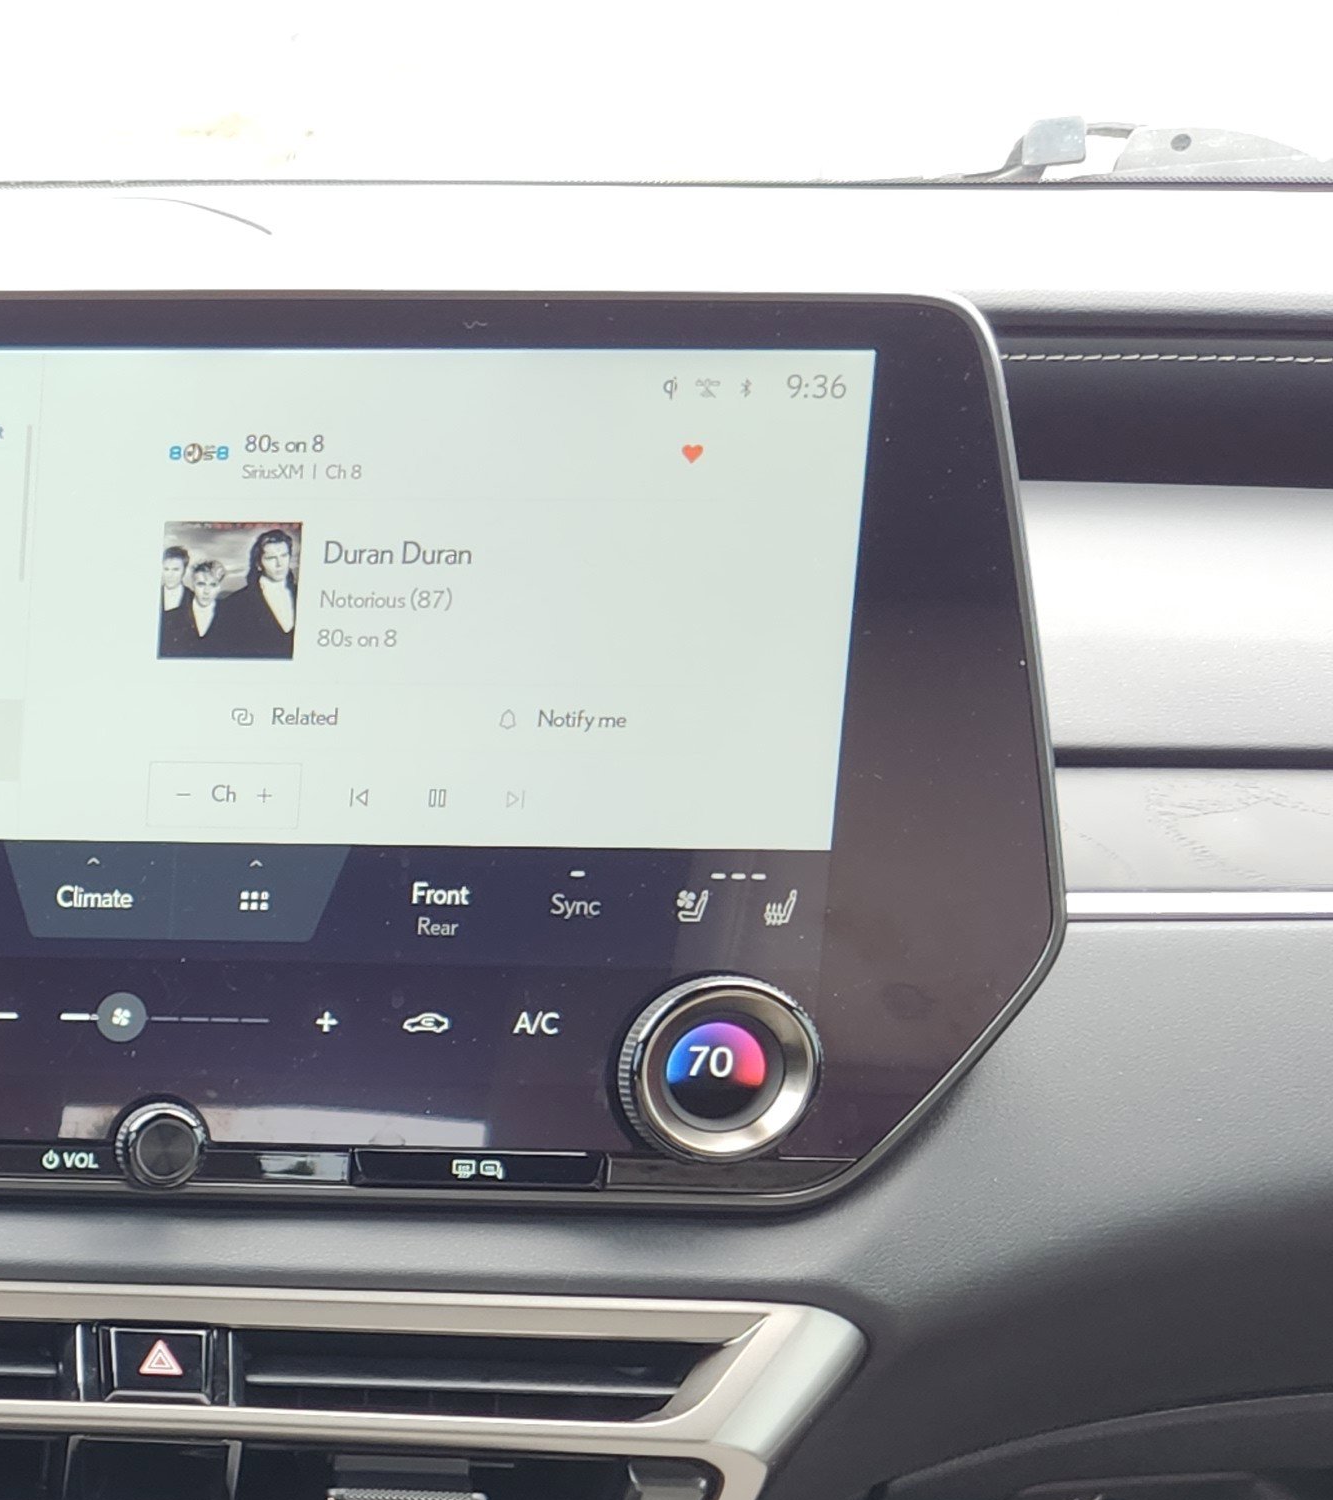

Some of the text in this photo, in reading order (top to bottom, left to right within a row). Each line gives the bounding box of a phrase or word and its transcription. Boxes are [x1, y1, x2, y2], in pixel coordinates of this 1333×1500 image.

[786, 373, 847, 399] 9:36
[244, 434, 325, 453] 80s on 8
[242, 464, 304, 480] SiriusXM
[325, 464, 347, 480] Ch
[350, 464, 362, 480] 8
[323, 540, 472, 565] Duran Duran
[319, 587, 453, 611] Notorious (87)
[317, 629, 397, 648] 80s on 8
[271, 706, 338, 726] Related
[537, 708, 627, 732] Notify me
[210, 784, 237, 805] Ch
[56, 885, 134, 910] Climate
[412, 881, 471, 906] Front
[550, 893, 602, 920] Sync
[417, 916, 459, 937] Rear
[512, 1011, 561, 1035] A/C
[687, 1045, 735, 1079] 70
[63, 1151, 99, 1169] VOL
